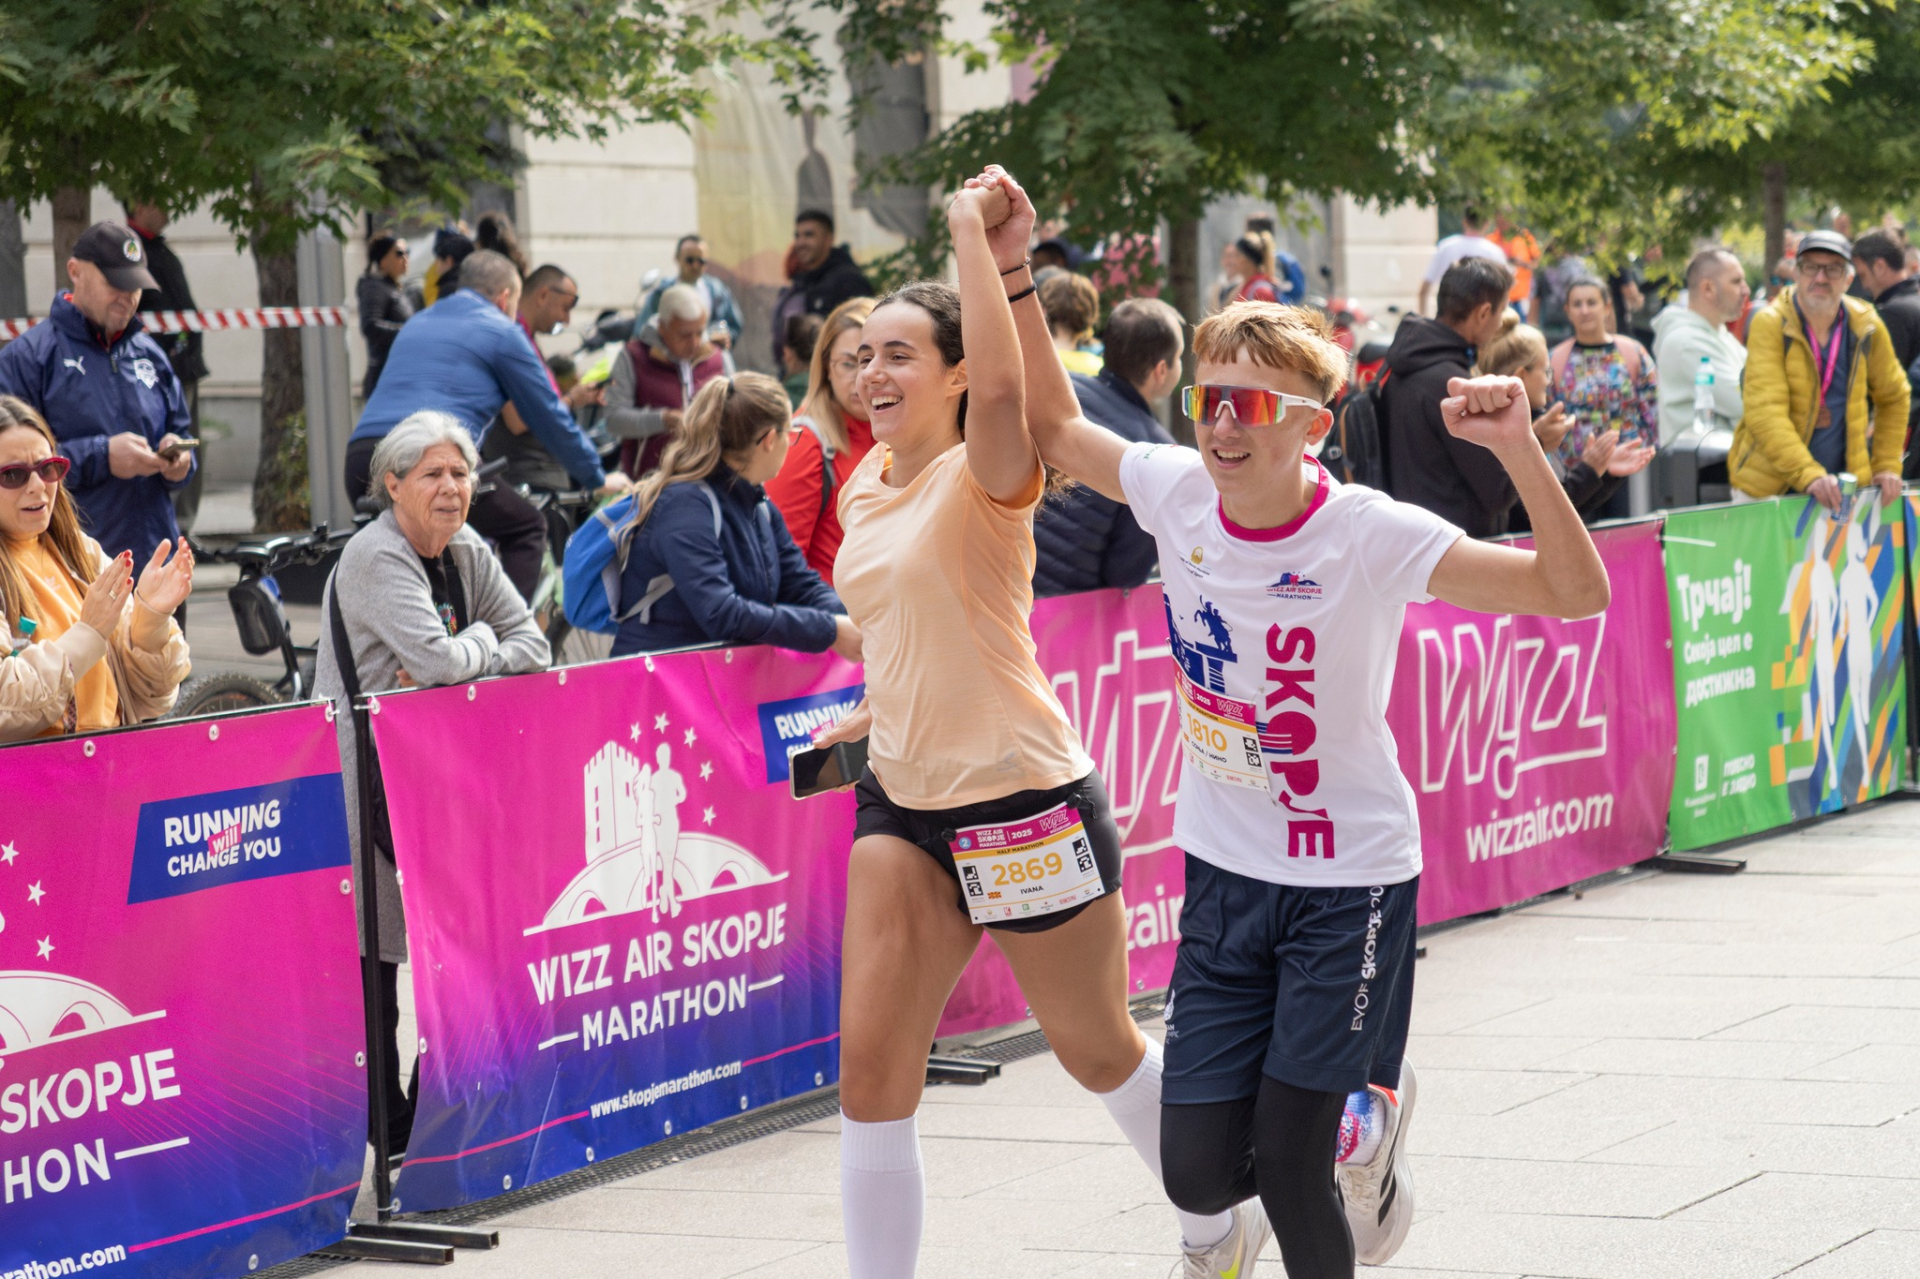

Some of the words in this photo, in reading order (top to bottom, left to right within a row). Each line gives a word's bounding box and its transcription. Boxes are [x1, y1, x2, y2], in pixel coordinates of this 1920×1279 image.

[1276, 593, 1312, 601] MARATHON
[1297, 587, 1323, 595] SKOPJE
[1676, 558, 1752, 632] Трчај!
[1743, 632, 1753, 651] е
[1685, 666, 1756, 708] достижна
[1186, 713, 1228, 752] 1810
[1265, 622, 1335, 860] SKOPJE
[164, 799, 281, 847] RUNNING
[212, 826, 238, 853] will
[977, 834, 1005, 843] SKOPJE
[1011, 829, 1033, 839] 2025
[1465, 793, 1615, 864] wizzair.com
[167, 846, 240, 877] CHANGE
[243, 836, 281, 861] YOU
[979, 840, 1007, 848] MARATHON
[1012, 841, 1044, 853] MARATHON
[990, 852, 1063, 887] 2869
[1020, 885, 1044, 895] IVANA
[527, 944, 613, 1005] WIZZ
[623, 931, 673, 983] AIR
[682, 902, 788, 968] SKOPJE
[1350, 983, 1369, 1031] EYOF
[1361, 909, 1382, 980] SKOPJE
[582, 974, 747, 1051] MARATHON
[0, 1049, 182, 1134] SKOPJE
[590, 1060, 743, 1119] www.skopjemarathon.com
